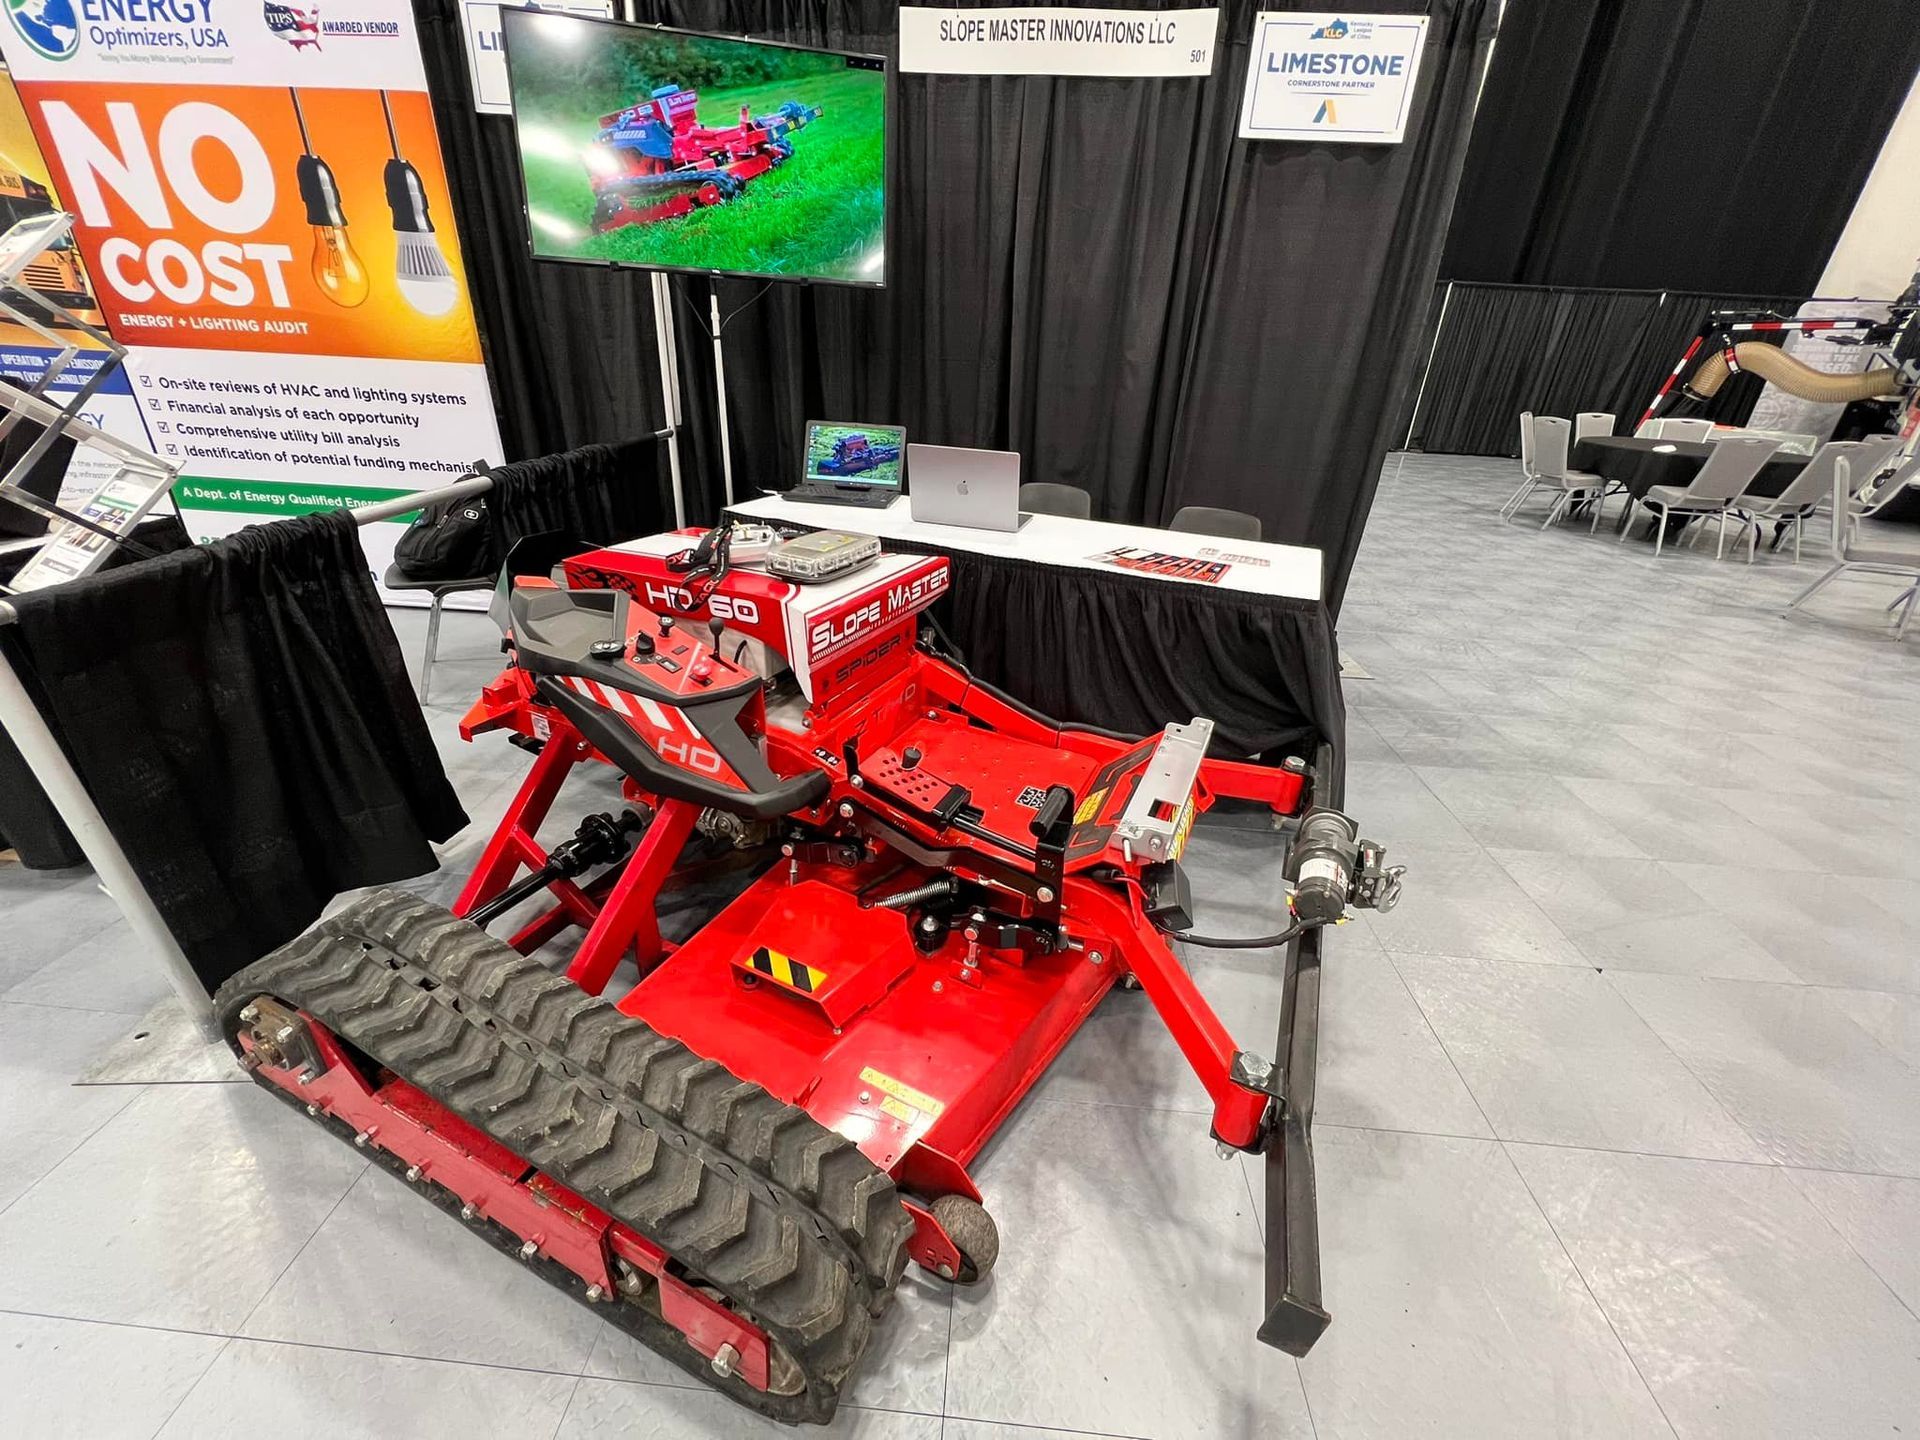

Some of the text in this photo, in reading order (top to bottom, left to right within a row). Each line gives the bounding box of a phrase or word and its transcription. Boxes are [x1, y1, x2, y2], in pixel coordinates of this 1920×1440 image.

[81, 0, 214, 23] ENERGY
[266, 12, 293, 25] TIPS
[90, 25, 229, 49] Optimizers, USA
[322, 21, 399, 34] AWARDED VENDOR
[940, 20, 1176, 44] SLOPE MASTER INNOVATIONS LLC
[1322, 26, 1344, 39] KLC
[1190, 49, 1206, 63] 501
[1267, 52, 1404, 76] LIMESTONE
[1287, 79, 1375, 89] CORNERSTONE PARTNER
[40, 100, 276, 235] NO
[100, 239, 293, 308] COST
[119, 313, 175, 329] ENERGY
[191, 317, 260, 333] LIGHTING
[264, 321, 309, 335] AUDIT
[158, 376, 467, 406] On-site reviews of HVAC and lighting systems
[167, 400, 420, 428] Financial analysis of each opportunity
[176, 423, 401, 448] Comprehensive utility bill analysis
[184, 445, 272, 463] Identification
[274, 451, 288, 464] of
[291, 452, 351, 467] potential
[353, 455, 406, 471] funding
[183, 487, 193, 498] A
[194, 488, 227, 501] Dept.
[229, 490, 242, 501] of
[244, 491, 286, 505] Energy
[289, 494, 343, 508] Qualified
[645, 581, 694, 611] HD
[707, 593, 760, 625] 60
[811, 565, 949, 655] SLOPE MASTER
[835, 634, 901, 684] SPIDER
[656, 735, 722, 774] HD
